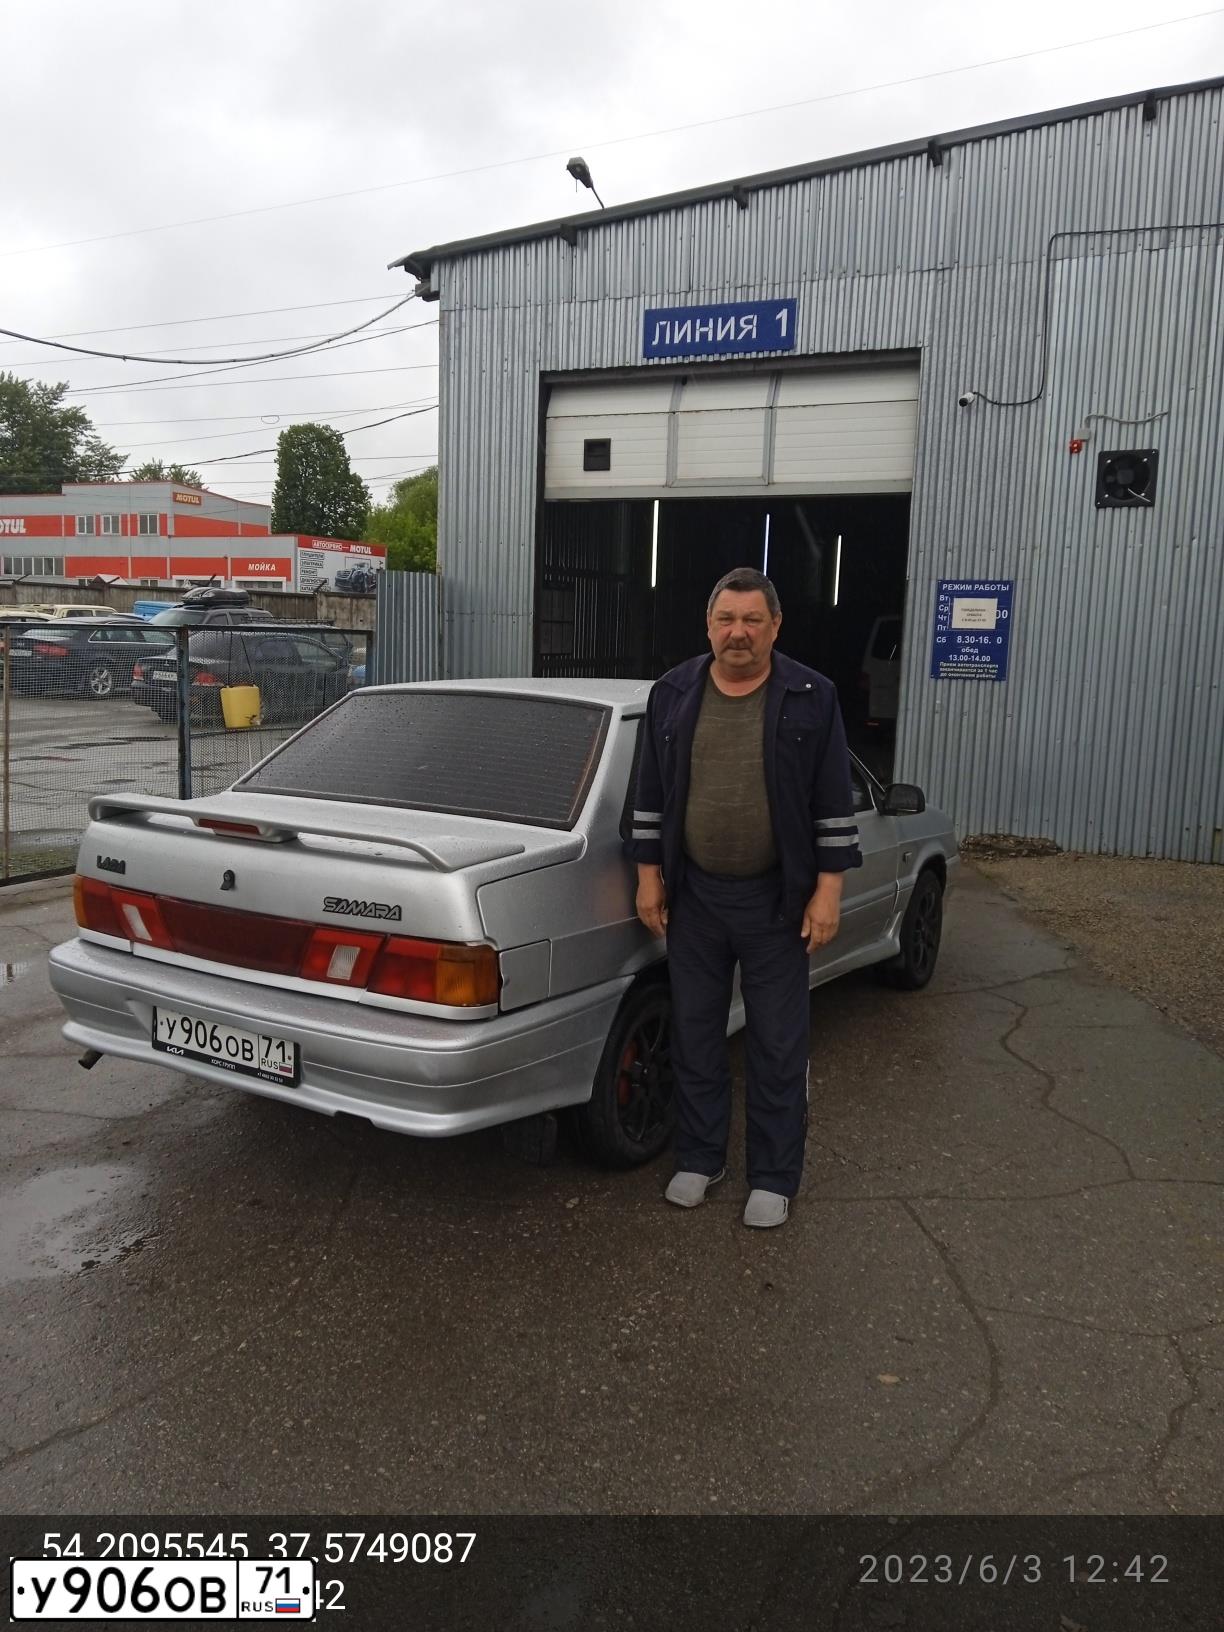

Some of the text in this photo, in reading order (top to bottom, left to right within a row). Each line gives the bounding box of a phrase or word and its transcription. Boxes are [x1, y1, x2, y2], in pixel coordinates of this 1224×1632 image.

[651, 308, 788, 346] ЛИНИЯ 1
[176, 493, 200, 504] MOTUL
[350, 544, 372, 554] MOTUL
[248, 562, 276, 572] МОЙКА
[942, 583, 1009, 591] РЕЖИМ РАБОТЫ
[939, 594, 949, 602] Вт
[938, 604, 949, 613] Ср
[948, 654, 991, 662] 13.00-14.00
[323, 896, 402, 921] SAMARA
[166, 1045, 184, 1056] KIA
[261, 1057, 278, 1070] RUS
